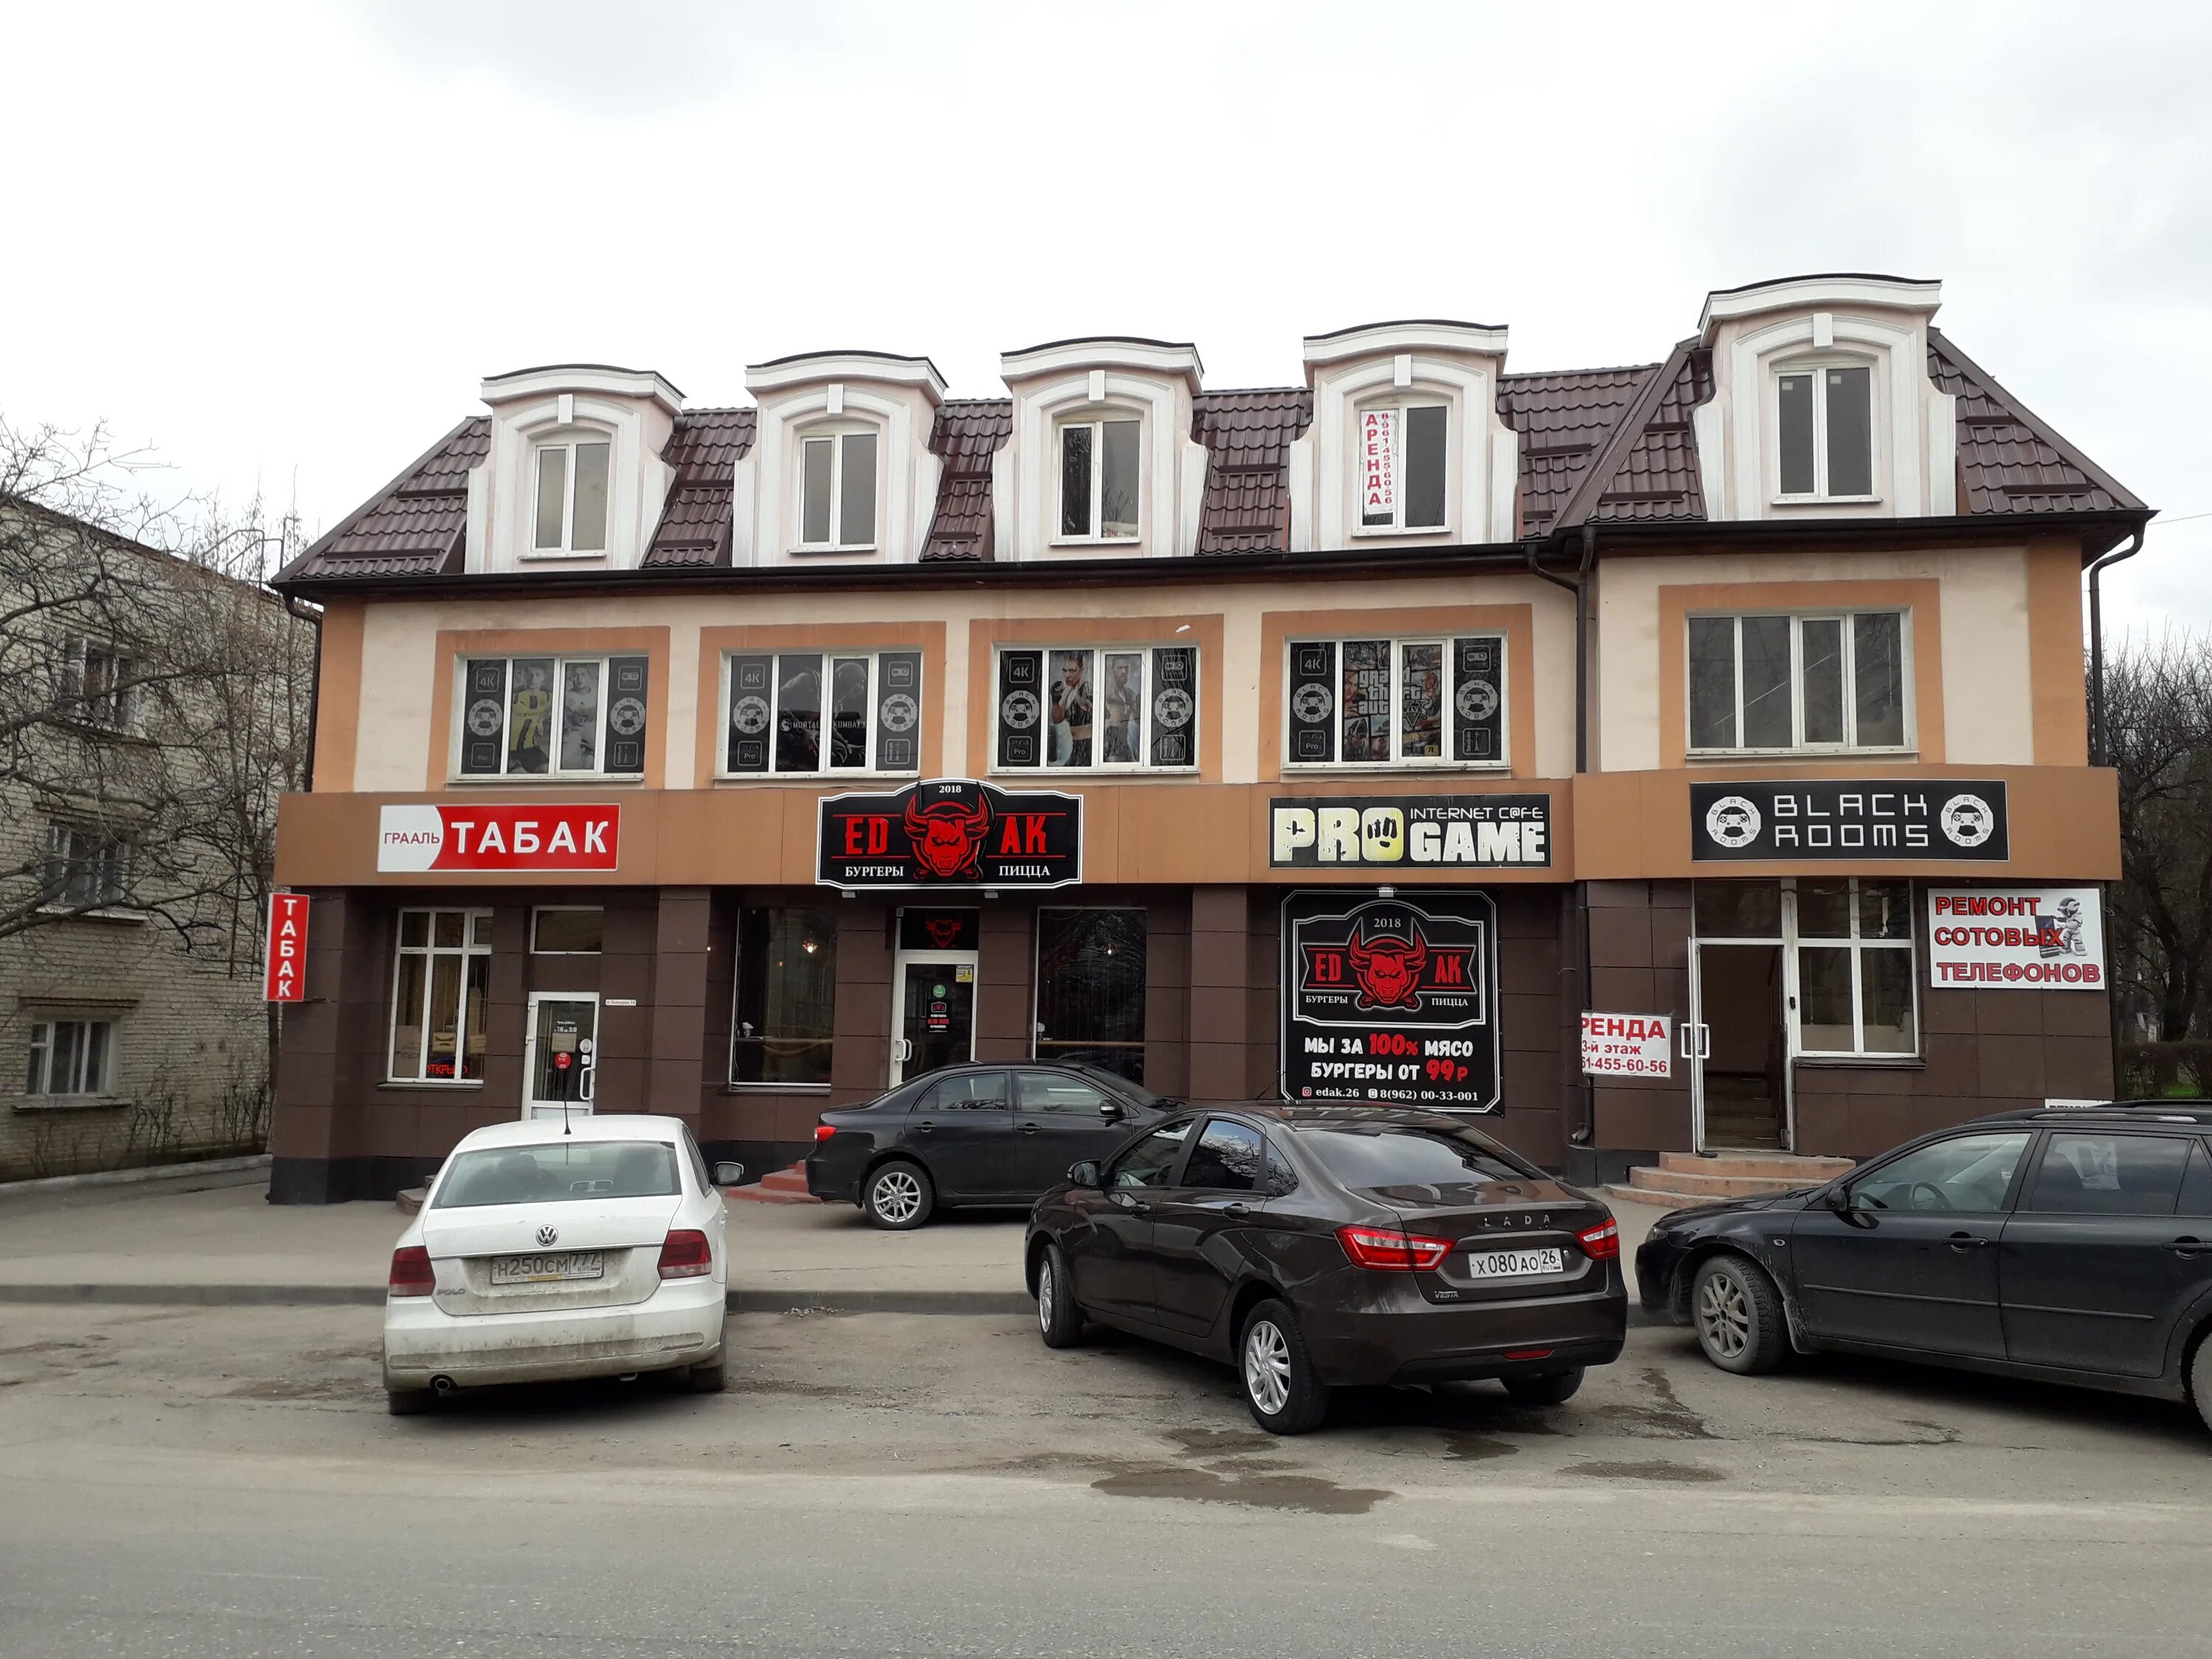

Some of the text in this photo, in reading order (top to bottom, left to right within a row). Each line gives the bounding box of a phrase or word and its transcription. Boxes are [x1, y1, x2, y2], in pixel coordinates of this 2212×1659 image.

[1366, 414, 1381, 505] АРЕНДА
[1304, 658, 1321, 669] 4K
[745, 672, 760, 684] 4K
[1013, 667, 1029, 678] 4K
[1359, 665, 1411, 688] grad
[939, 785, 961, 793] 2018
[1773, 793, 1927, 816] BLACK
[1410, 808, 1493, 819] INTERNET
[384, 832, 440, 844] ГРААЛЬ
[451, 821, 608, 854] ТАБАК
[845, 815, 1047, 855] ED AK
[1273, 807, 1545, 861] PRO GAME
[1775, 824, 1929, 846] ROOMS
[844, 865, 1051, 877] БУРГЕРЫ ПИЦЦА
[1935, 897, 2041, 916] РЕМОНТ
[1374, 918, 1401, 928] 2018
[1934, 927, 2065, 947] СОТОВЫХ
[278, 899, 297, 998] ТАБАК
[1315, 953, 1462, 984] ED AK
[1936, 962, 2101, 983] ТЕЛЕФОНОВ
[1305, 995, 1469, 1007] БУРГЕРЫ ПИЦЦА
[1304, 1033, 1474, 1057] МЫ ЗА 100% МЯСО
[1582, 1040, 1641, 1055] 3-й этаж
[1310, 1062, 1392, 1080] БУРГЕРЫ
[1398, 1065, 1420, 1080] ОТ
[1315, 1087, 1360, 1097] edak.26
[1380, 1089, 1478, 1101] 8(962) 00-33-001
[1484, 1214, 1550, 1227] LADA
[571, 1253, 597, 1267] 777
[1541, 1250, 1557, 1265] 26
